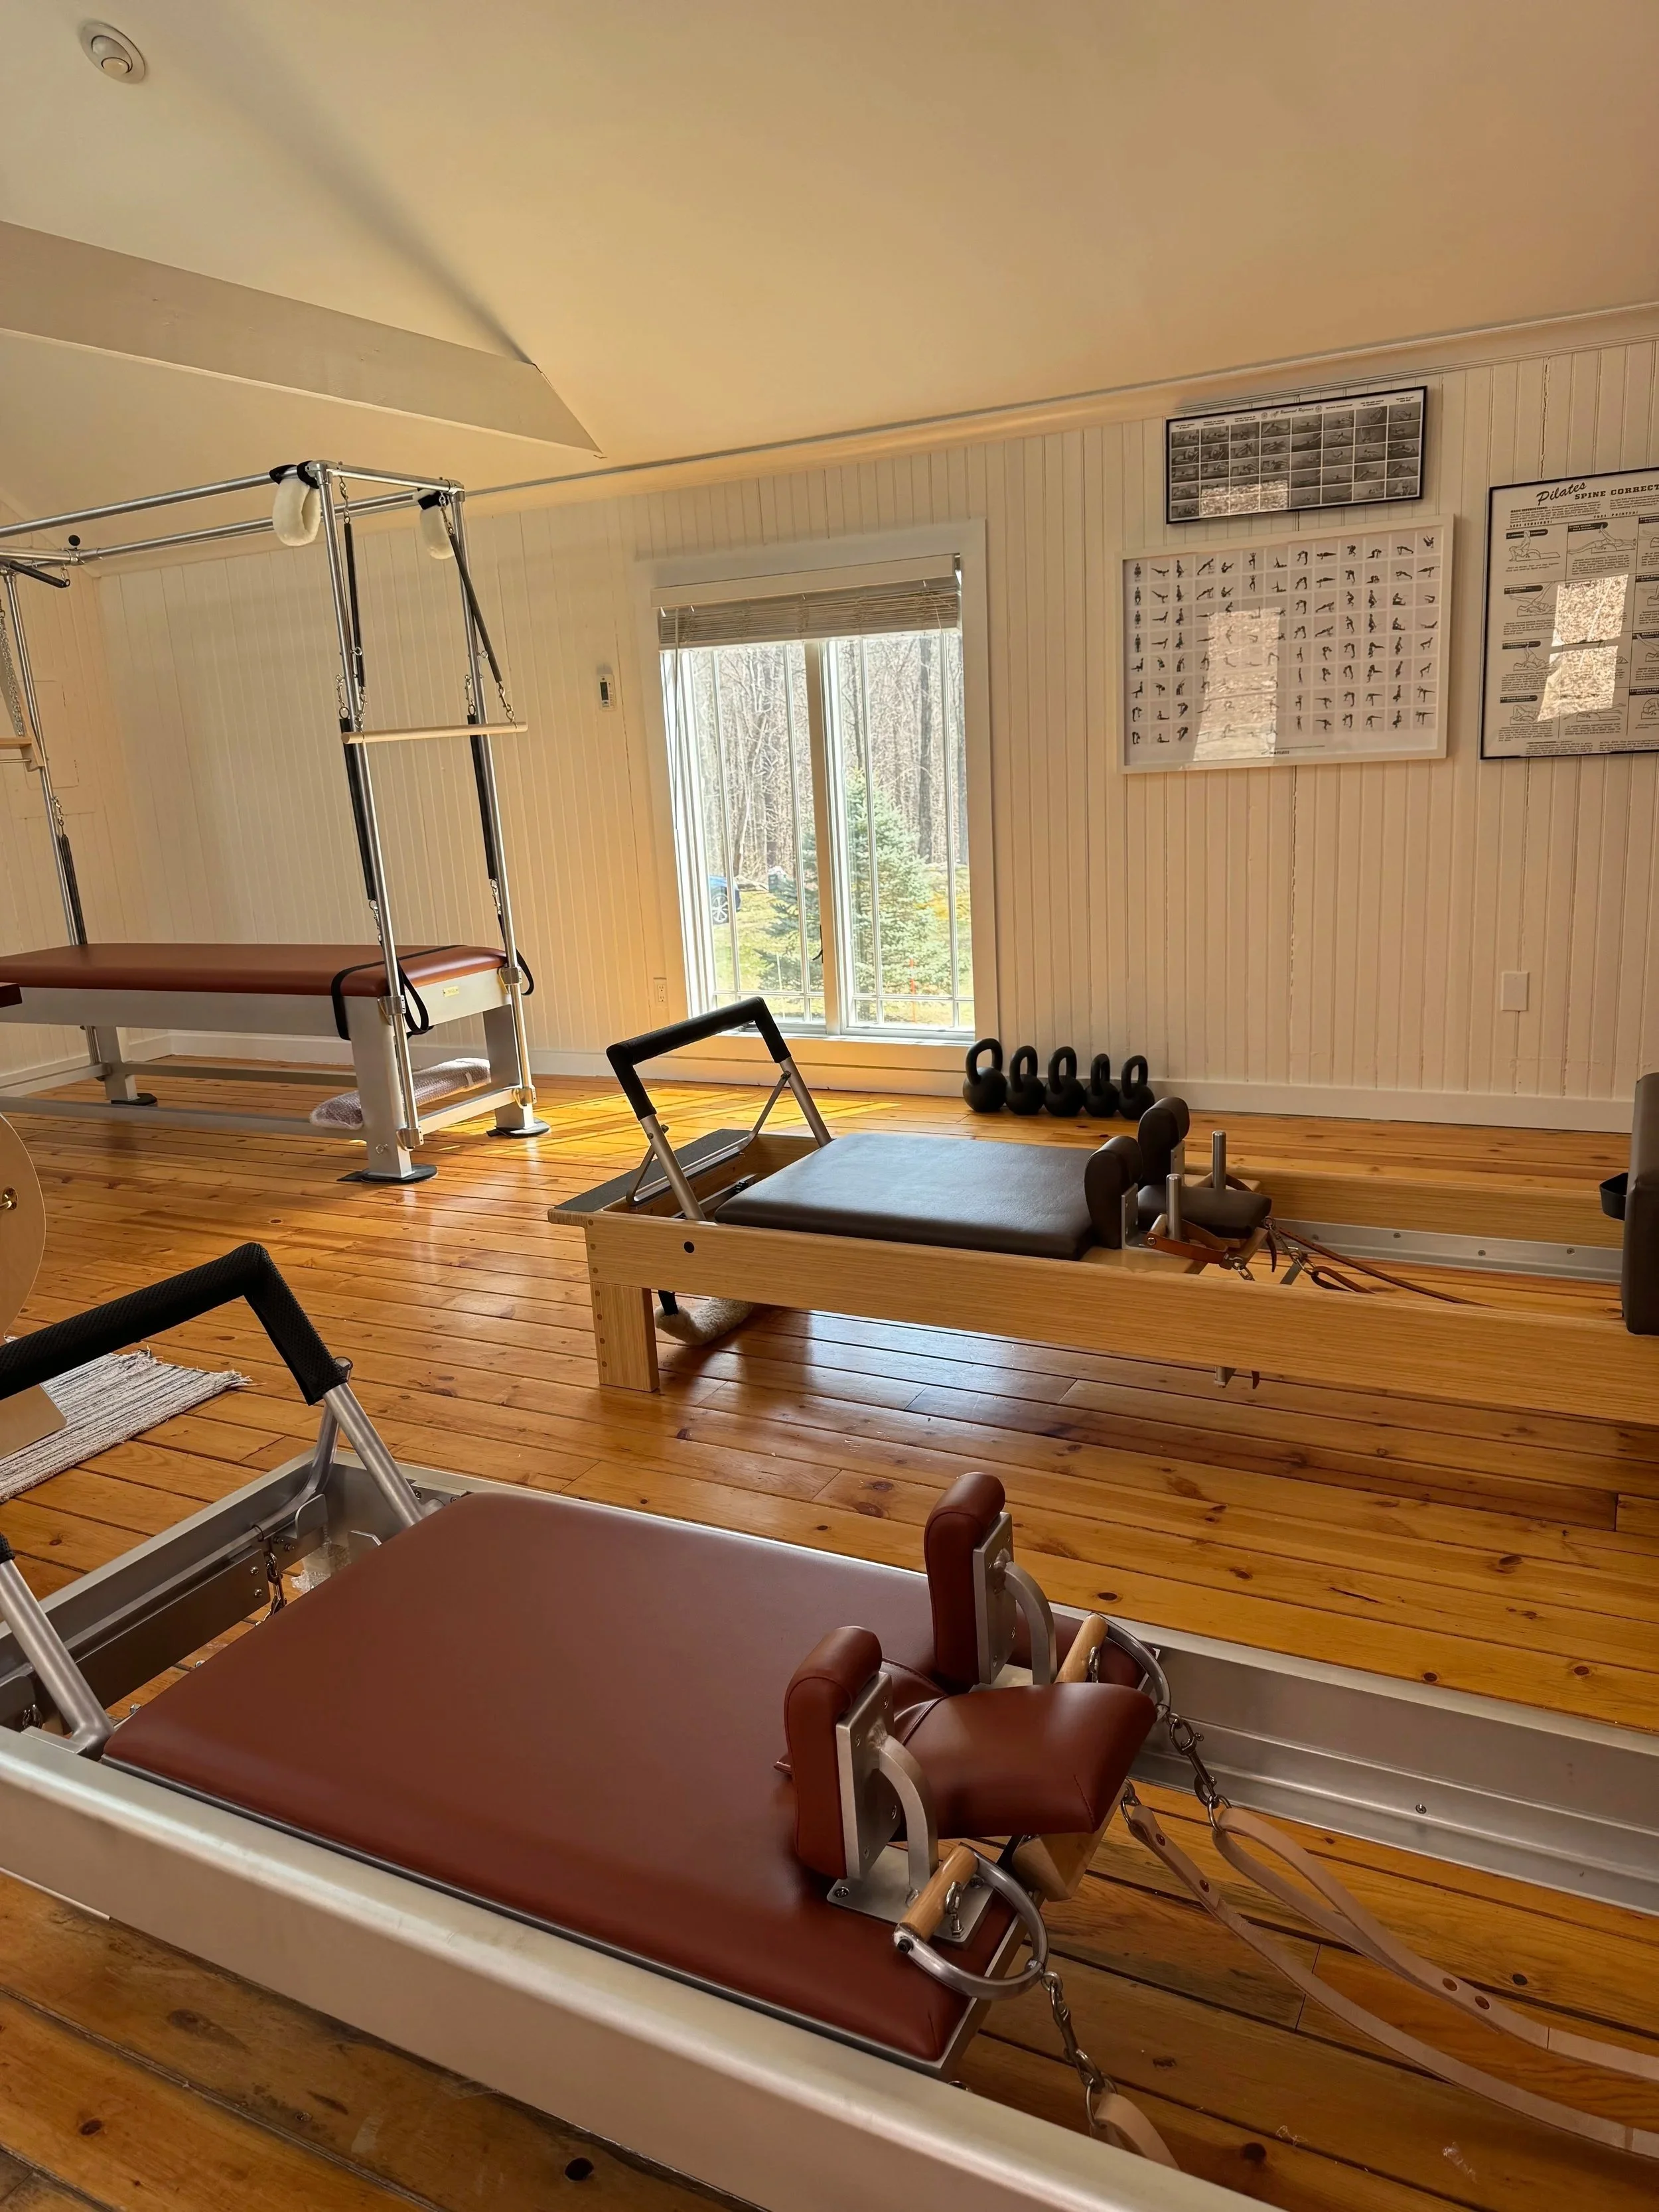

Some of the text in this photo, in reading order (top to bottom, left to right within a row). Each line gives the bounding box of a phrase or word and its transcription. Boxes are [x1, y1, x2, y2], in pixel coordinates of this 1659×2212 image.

[1536, 482, 1587, 506] Pilates
[1575, 484, 1659, 500] SPINE CORRECT
